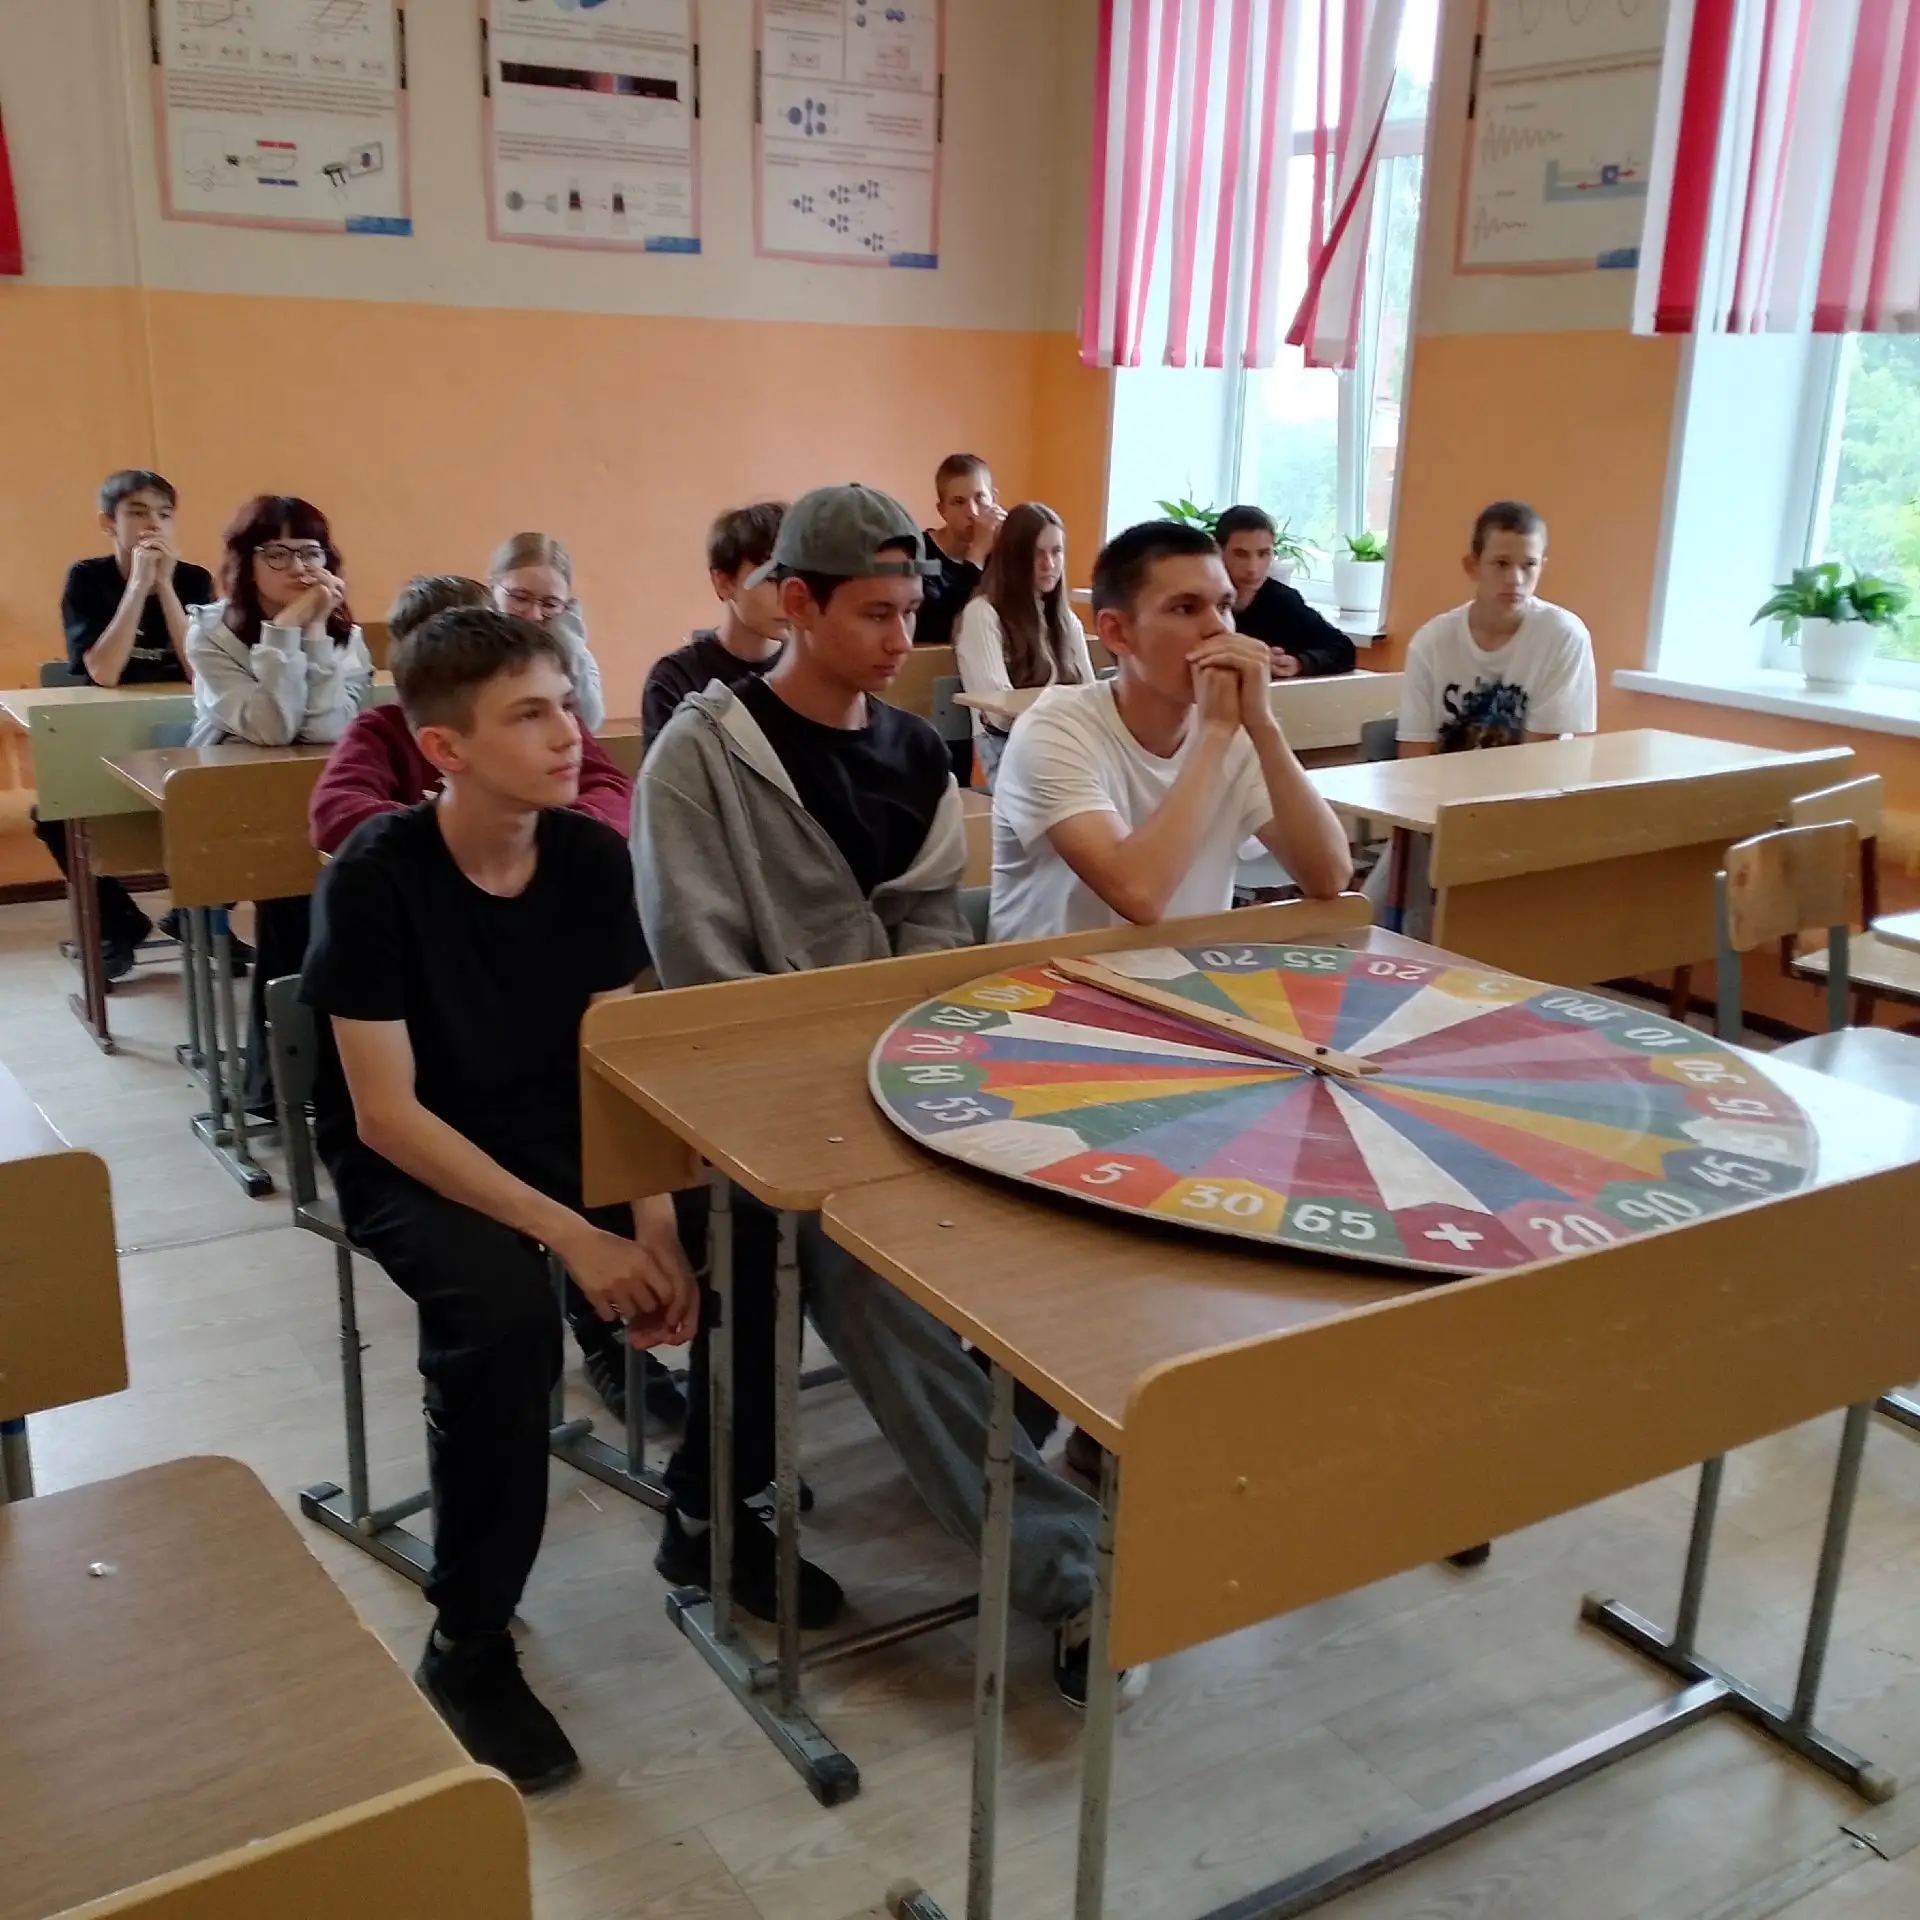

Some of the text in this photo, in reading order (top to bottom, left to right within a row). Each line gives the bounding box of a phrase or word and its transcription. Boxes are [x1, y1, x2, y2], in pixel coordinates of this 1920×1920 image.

[1200, 949, 1260, 968] 70
[1283, 951, 1338, 971] 35
[1367, 960, 1427, 981] 20
[930, 1006, 992, 1027] 20
[905, 1033, 964, 1055] 70
[1624, 1027, 1689, 1047] 10
[915, 1097, 994, 1123] 55
[1707, 1096, 1776, 1117] 15
[1080, 1162, 1136, 1185] 5
[1690, 1155, 1774, 1197] 45
[1181, 1184, 1264, 1216] 30
[1616, 1189, 1701, 1230] 90
[1292, 1204, 1377, 1241] 65
[1528, 1214, 1616, 1253] 20
